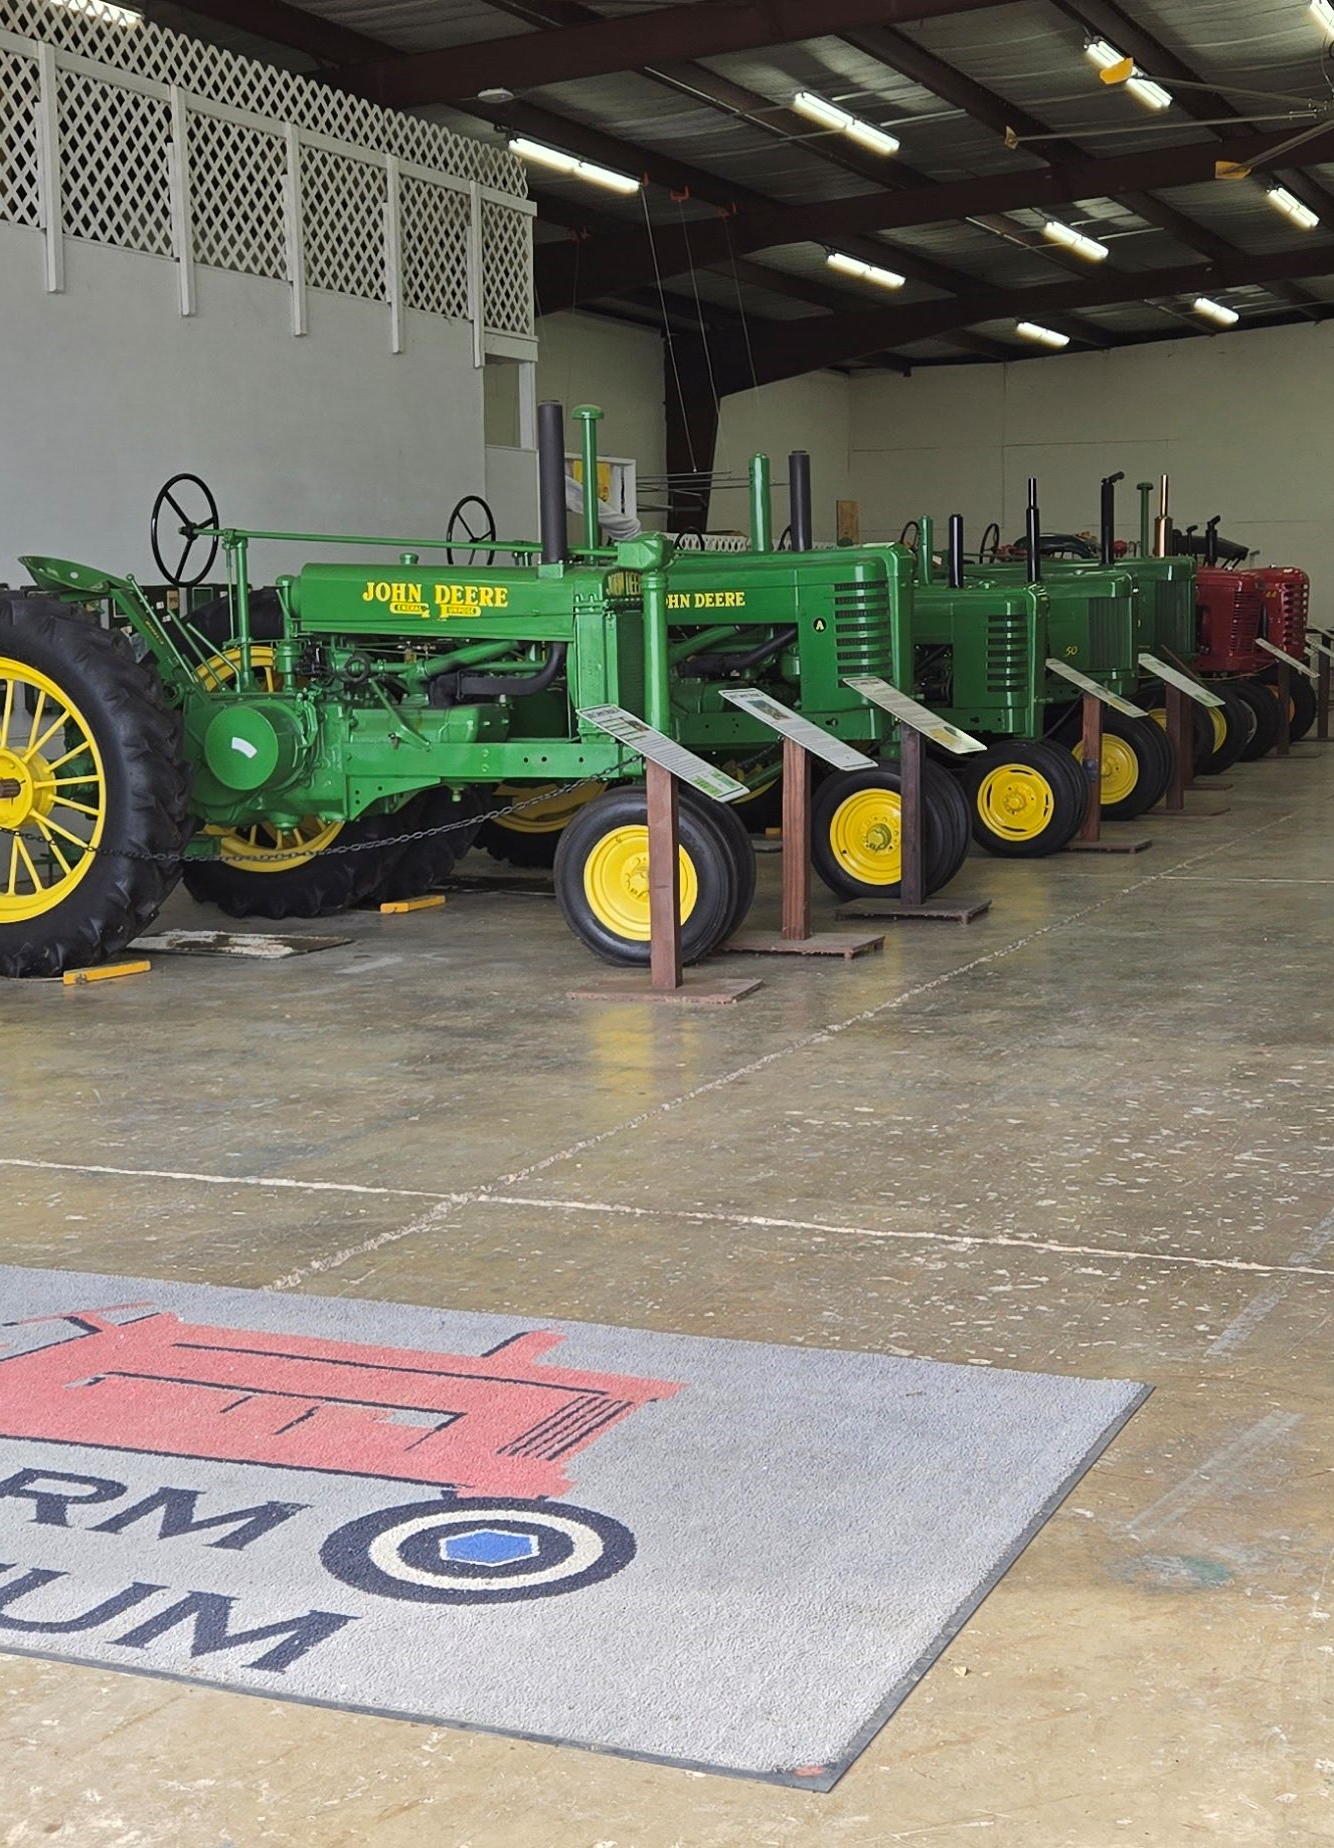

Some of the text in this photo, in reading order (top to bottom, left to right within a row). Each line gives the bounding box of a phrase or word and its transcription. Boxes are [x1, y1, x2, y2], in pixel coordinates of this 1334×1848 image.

[362, 582, 509, 608] JOHN DEERE
[665, 591, 746, 609] HN DEERE
[815, 619, 825, 631] A
